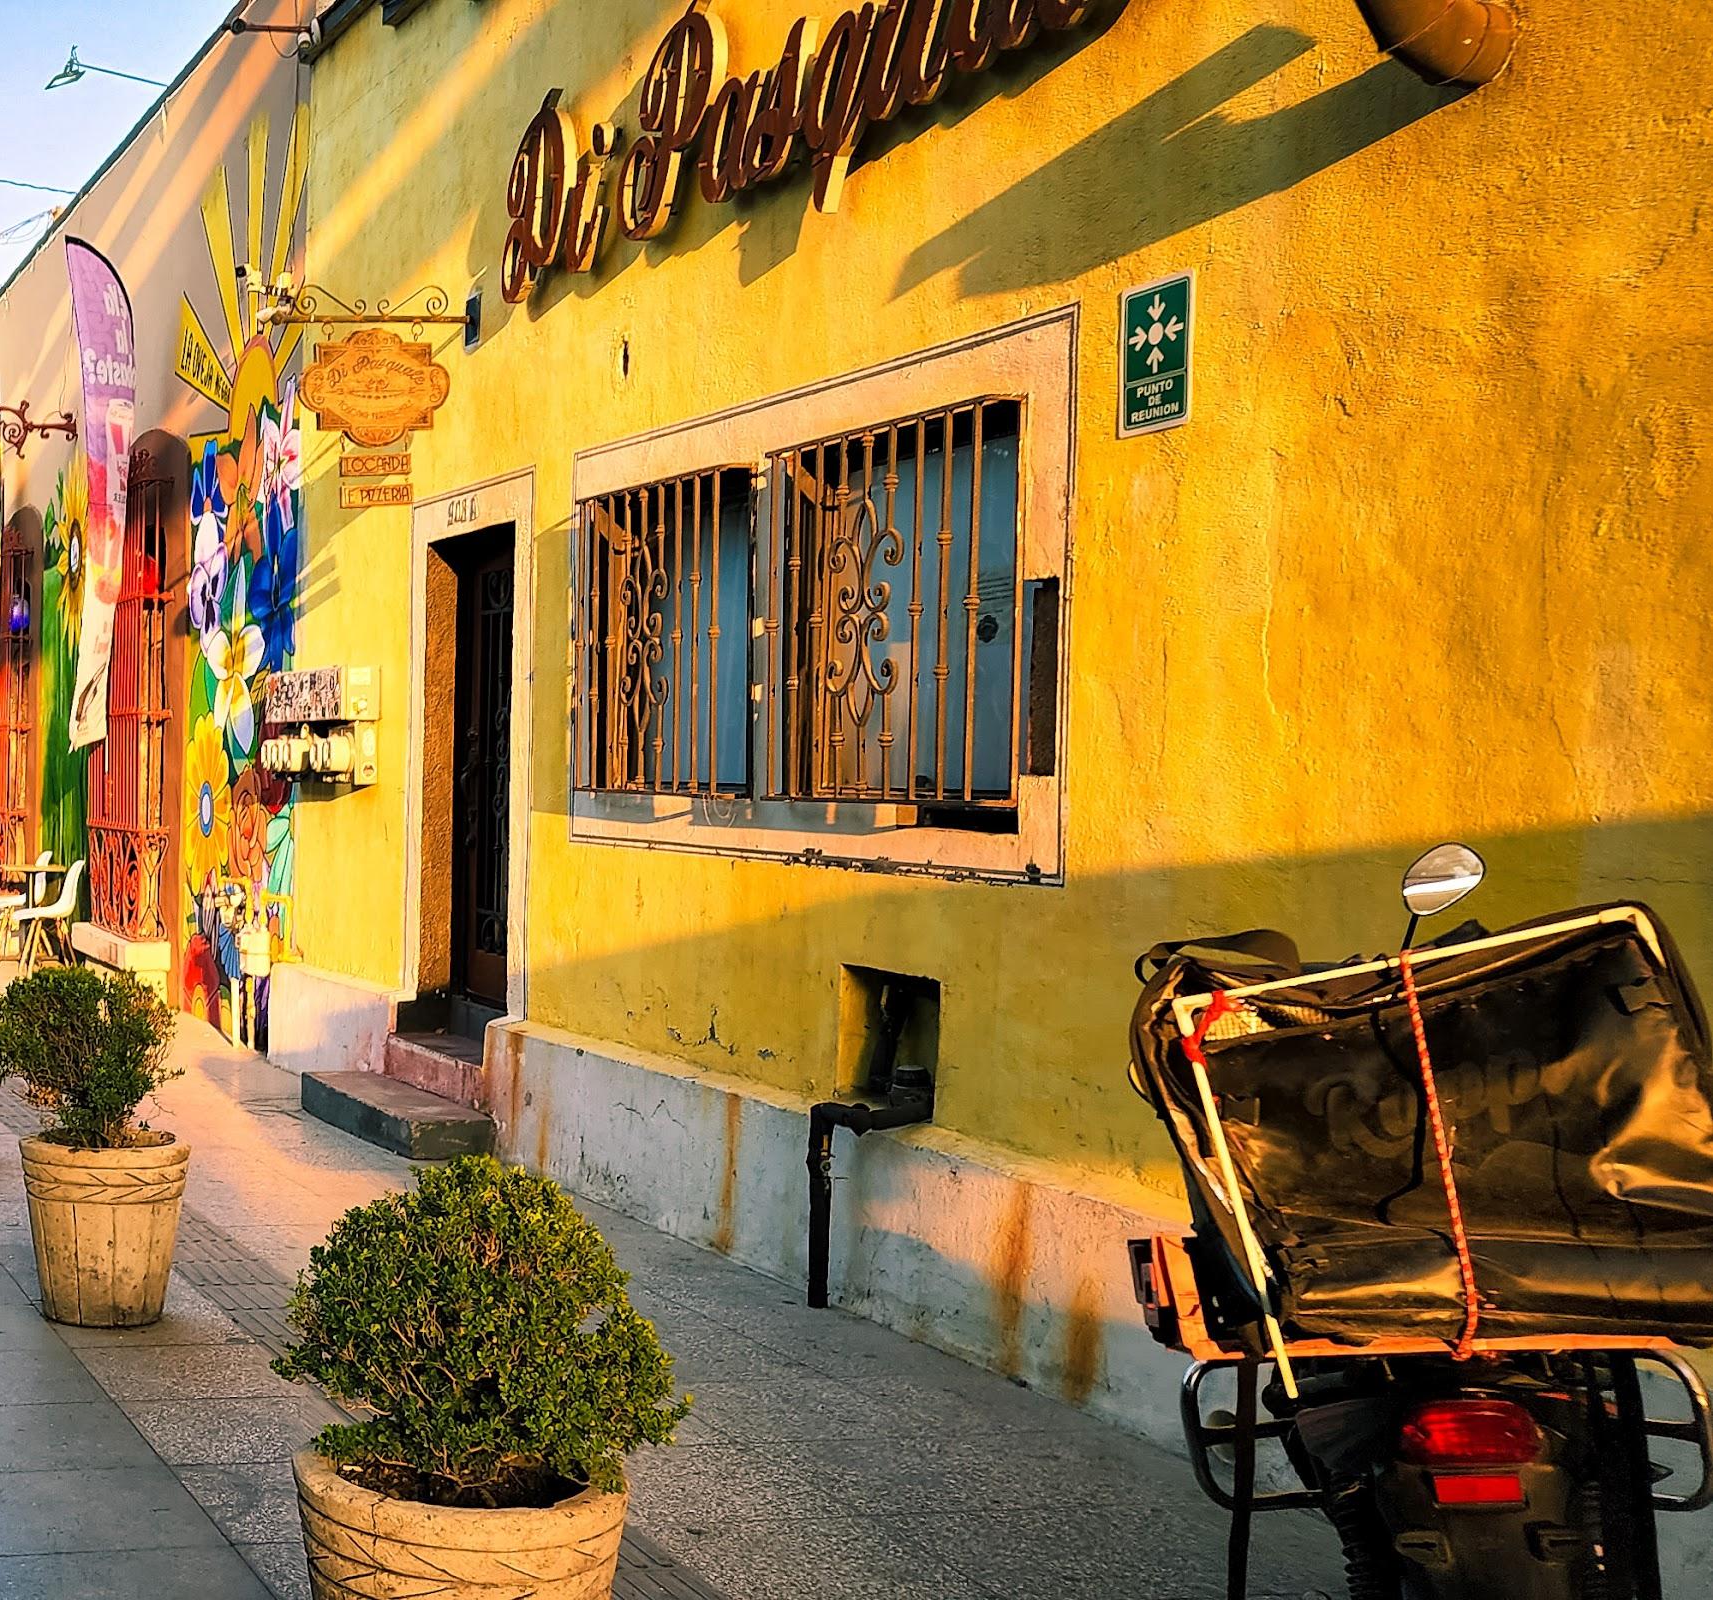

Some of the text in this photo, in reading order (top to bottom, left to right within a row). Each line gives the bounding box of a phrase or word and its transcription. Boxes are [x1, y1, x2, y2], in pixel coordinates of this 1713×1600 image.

[501, 88, 618, 304] Di
[181, 325, 193, 372] LA
[192, 341, 214, 390] OVEJA
[327, 355, 426, 388] Di Pasquale
[1137, 379, 1174, 398] PUNTO
[1148, 394, 1163, 407] DE
[1131, 402, 1180, 423] REUNION
[345, 458, 409, 473] LOCANDA
[361, 486, 410, 502] PIZZERIA
